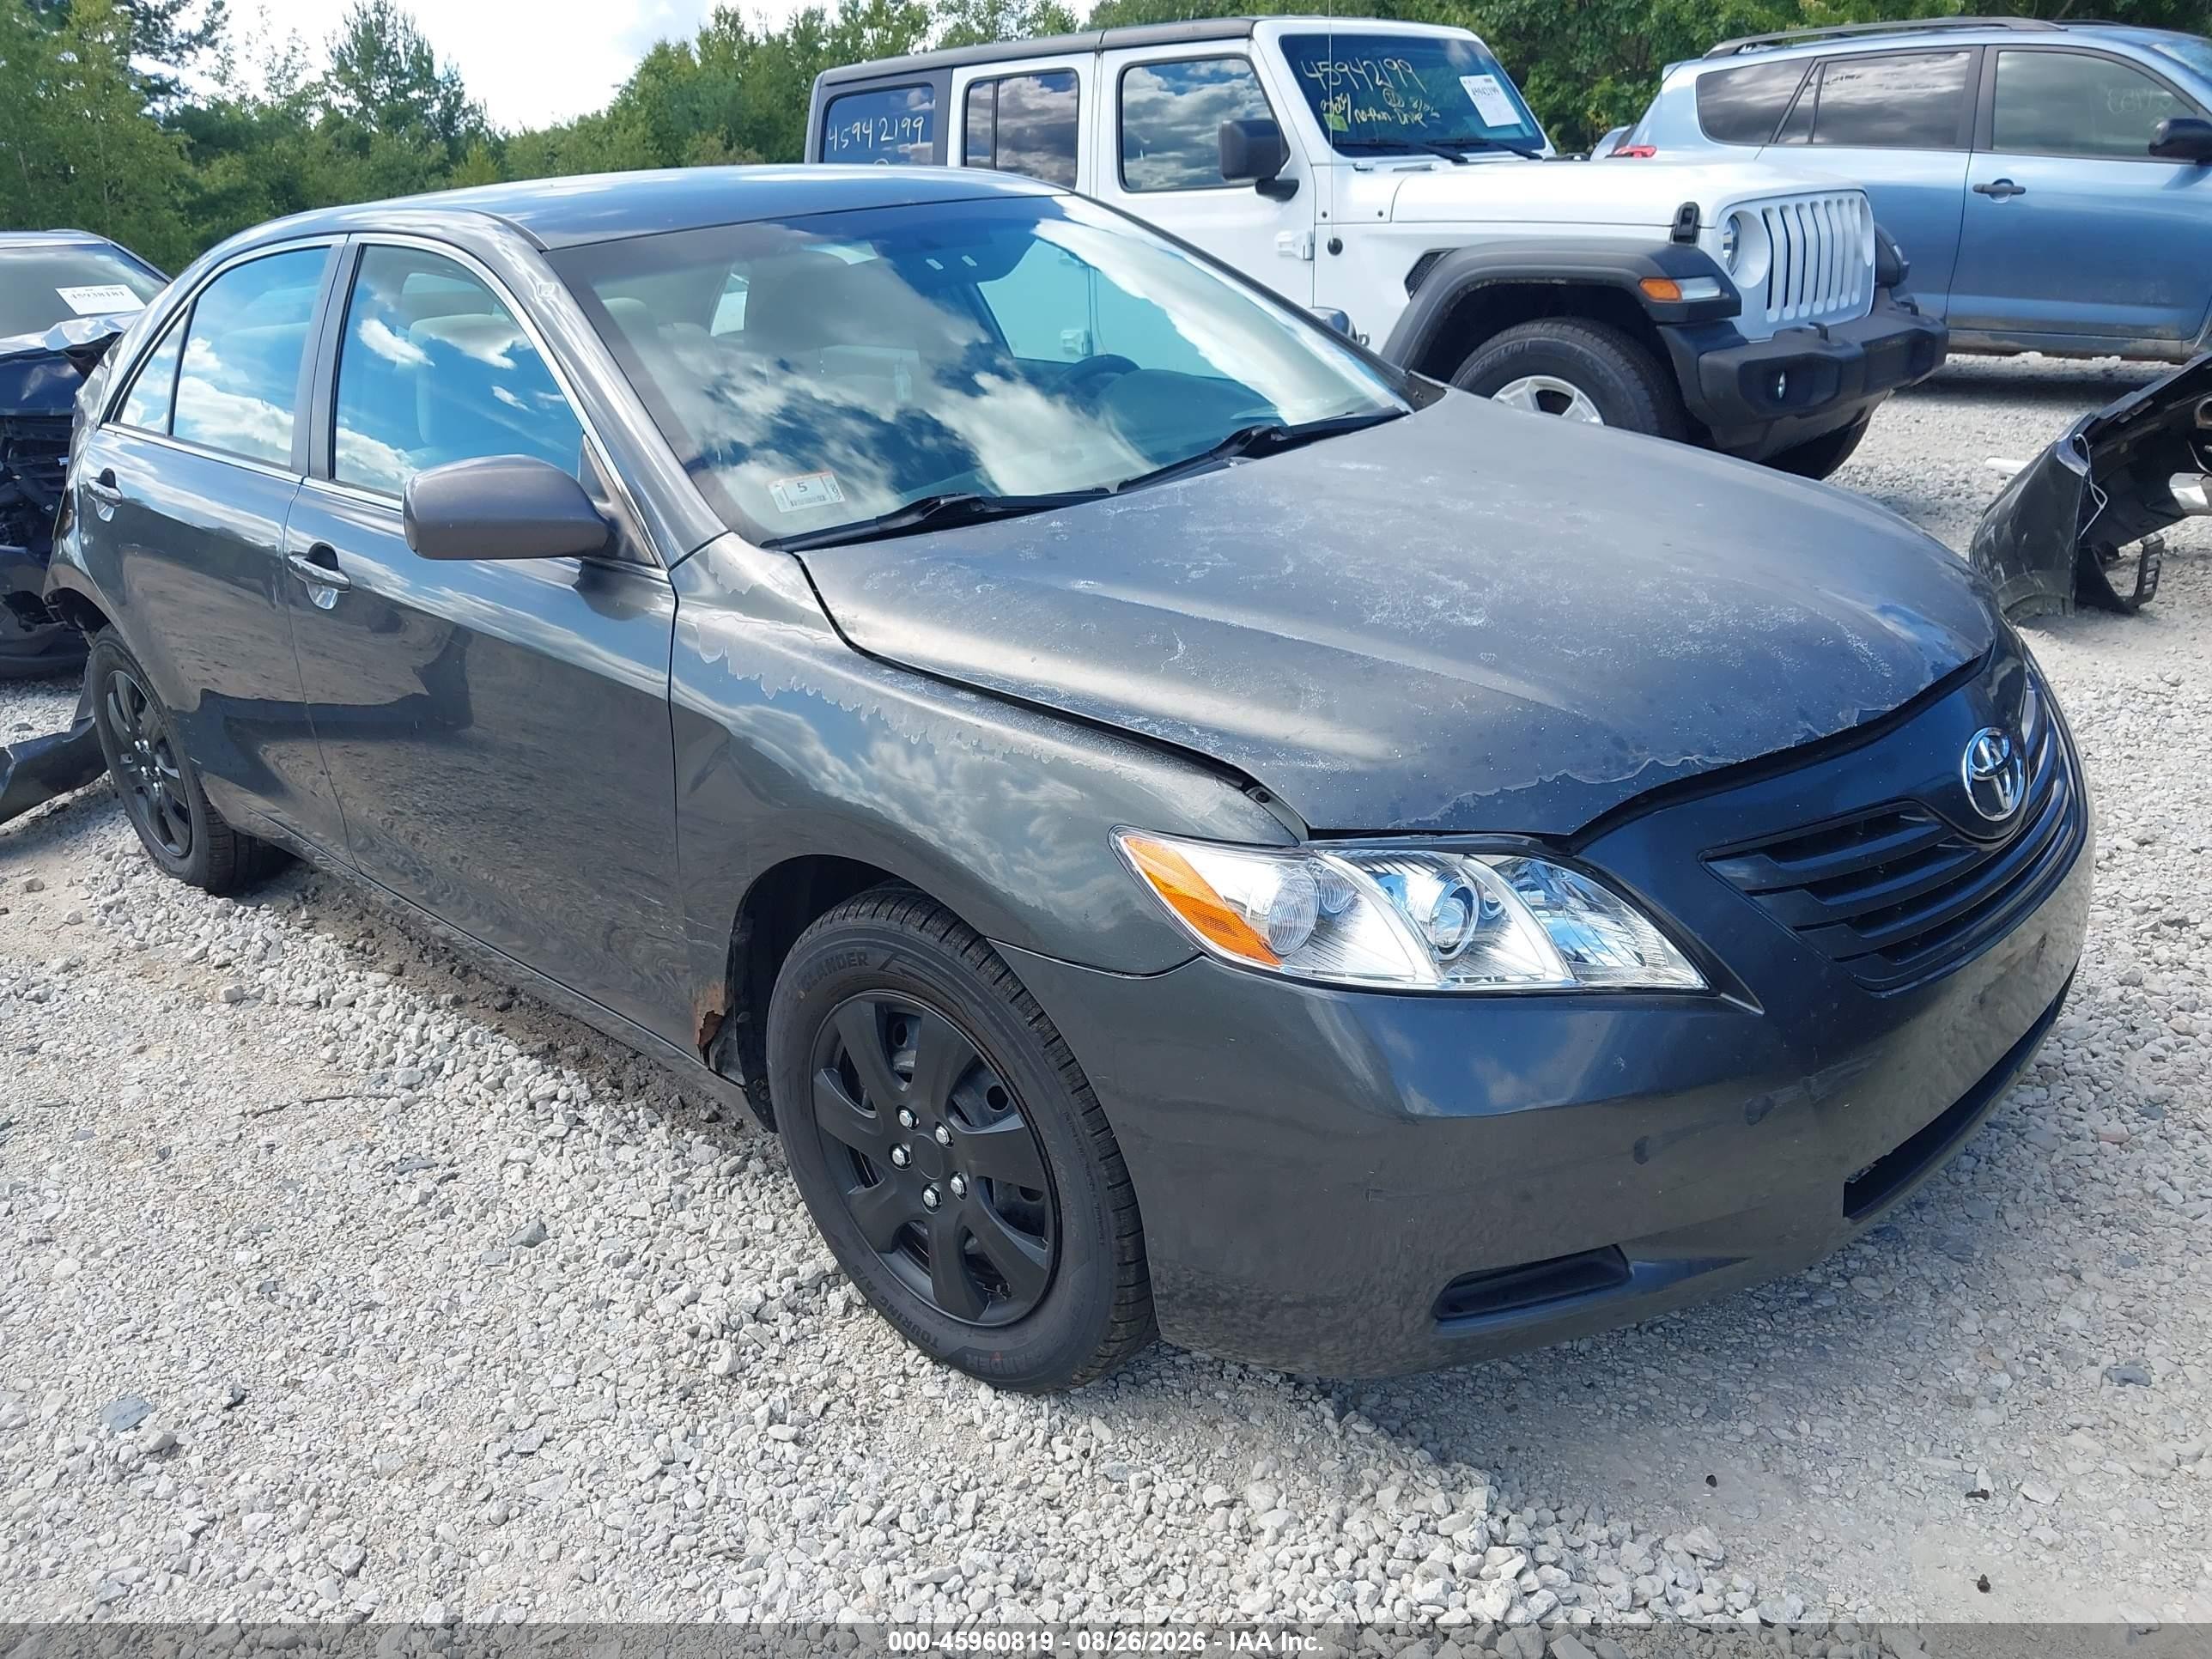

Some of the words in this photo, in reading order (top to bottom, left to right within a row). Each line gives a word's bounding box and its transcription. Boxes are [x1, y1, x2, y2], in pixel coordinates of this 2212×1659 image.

[1299, 57, 1428, 93] 45942199
[796, 481, 808, 493] 5
[877, 1295, 940, 1350] TOURING
